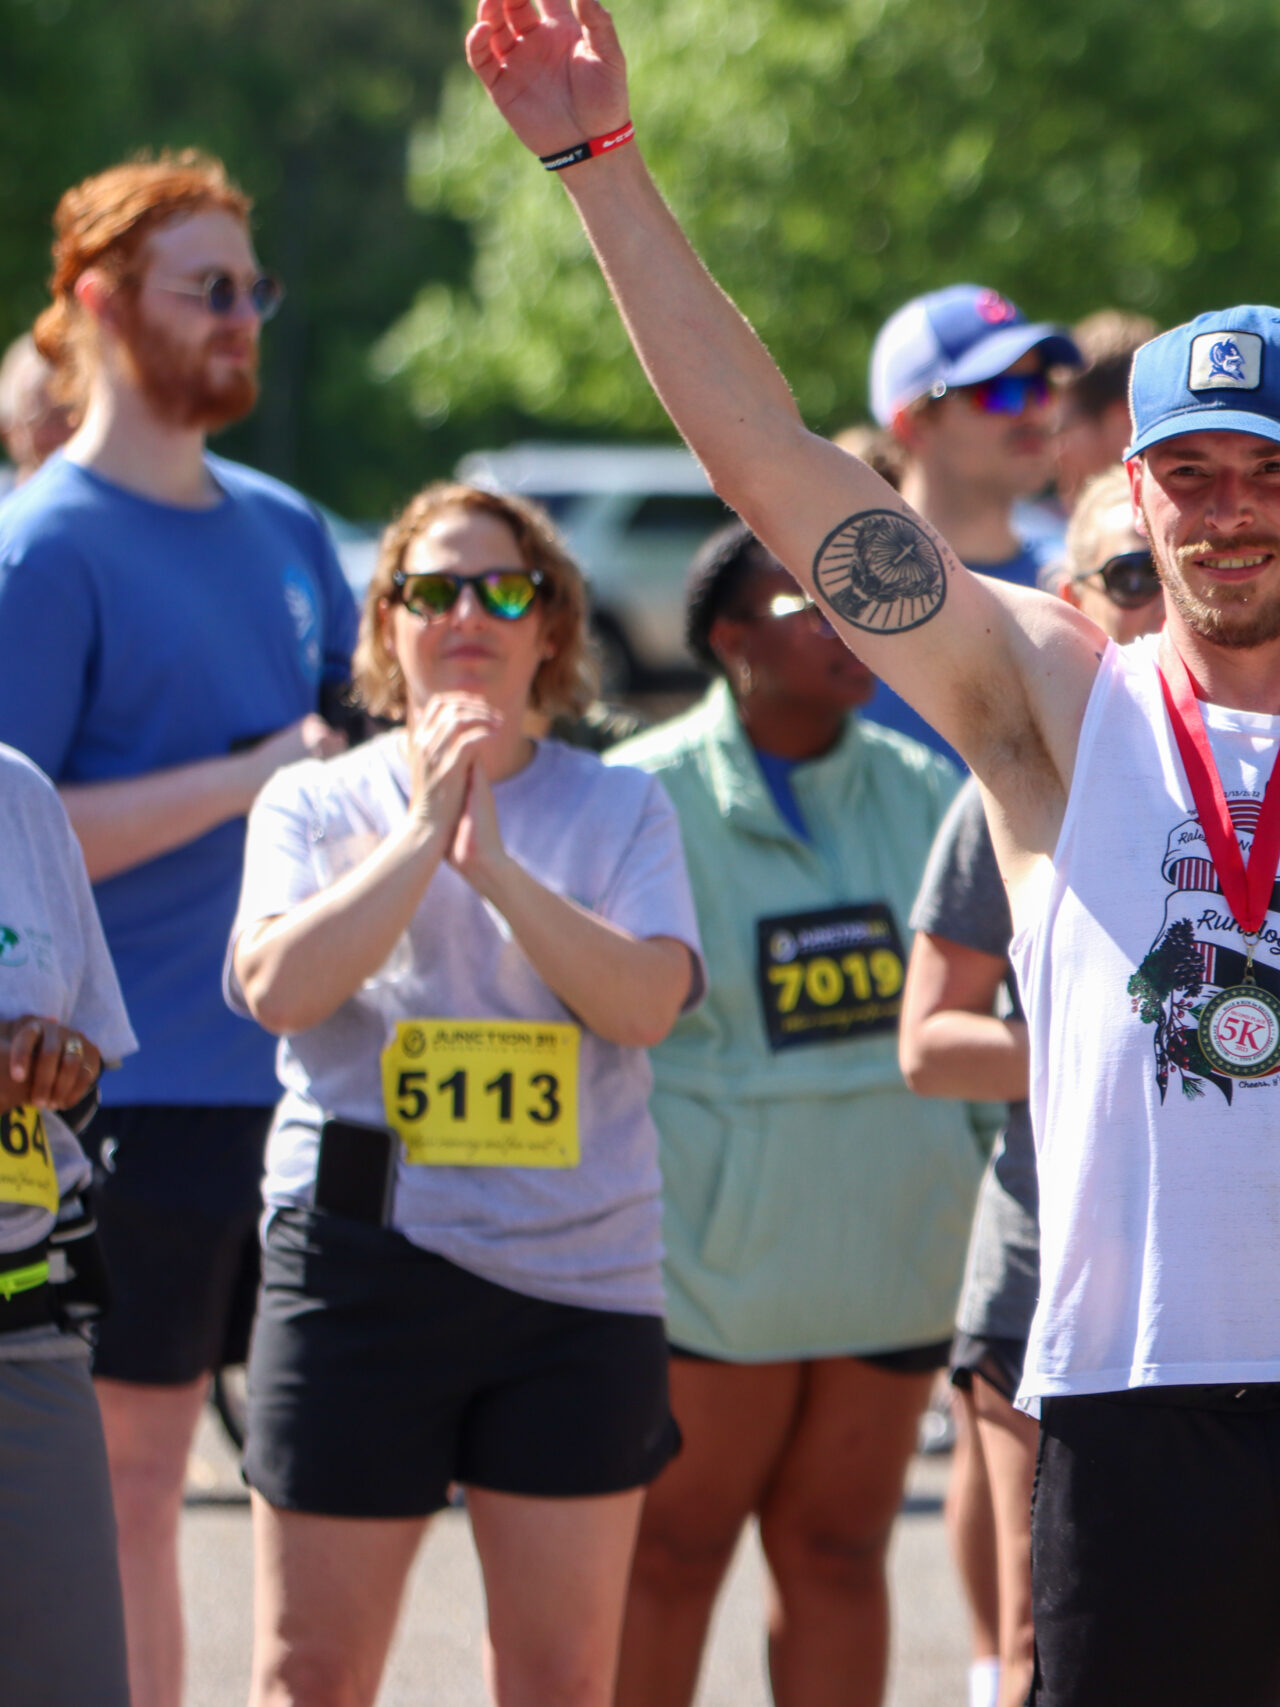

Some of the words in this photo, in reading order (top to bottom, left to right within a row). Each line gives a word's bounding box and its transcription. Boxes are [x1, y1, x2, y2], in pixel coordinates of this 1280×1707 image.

[1178, 829, 1206, 845] Rale
[768, 949, 903, 1013] 7019
[1219, 1016, 1266, 1050] 5K
[397, 1069, 561, 1125] 5113
